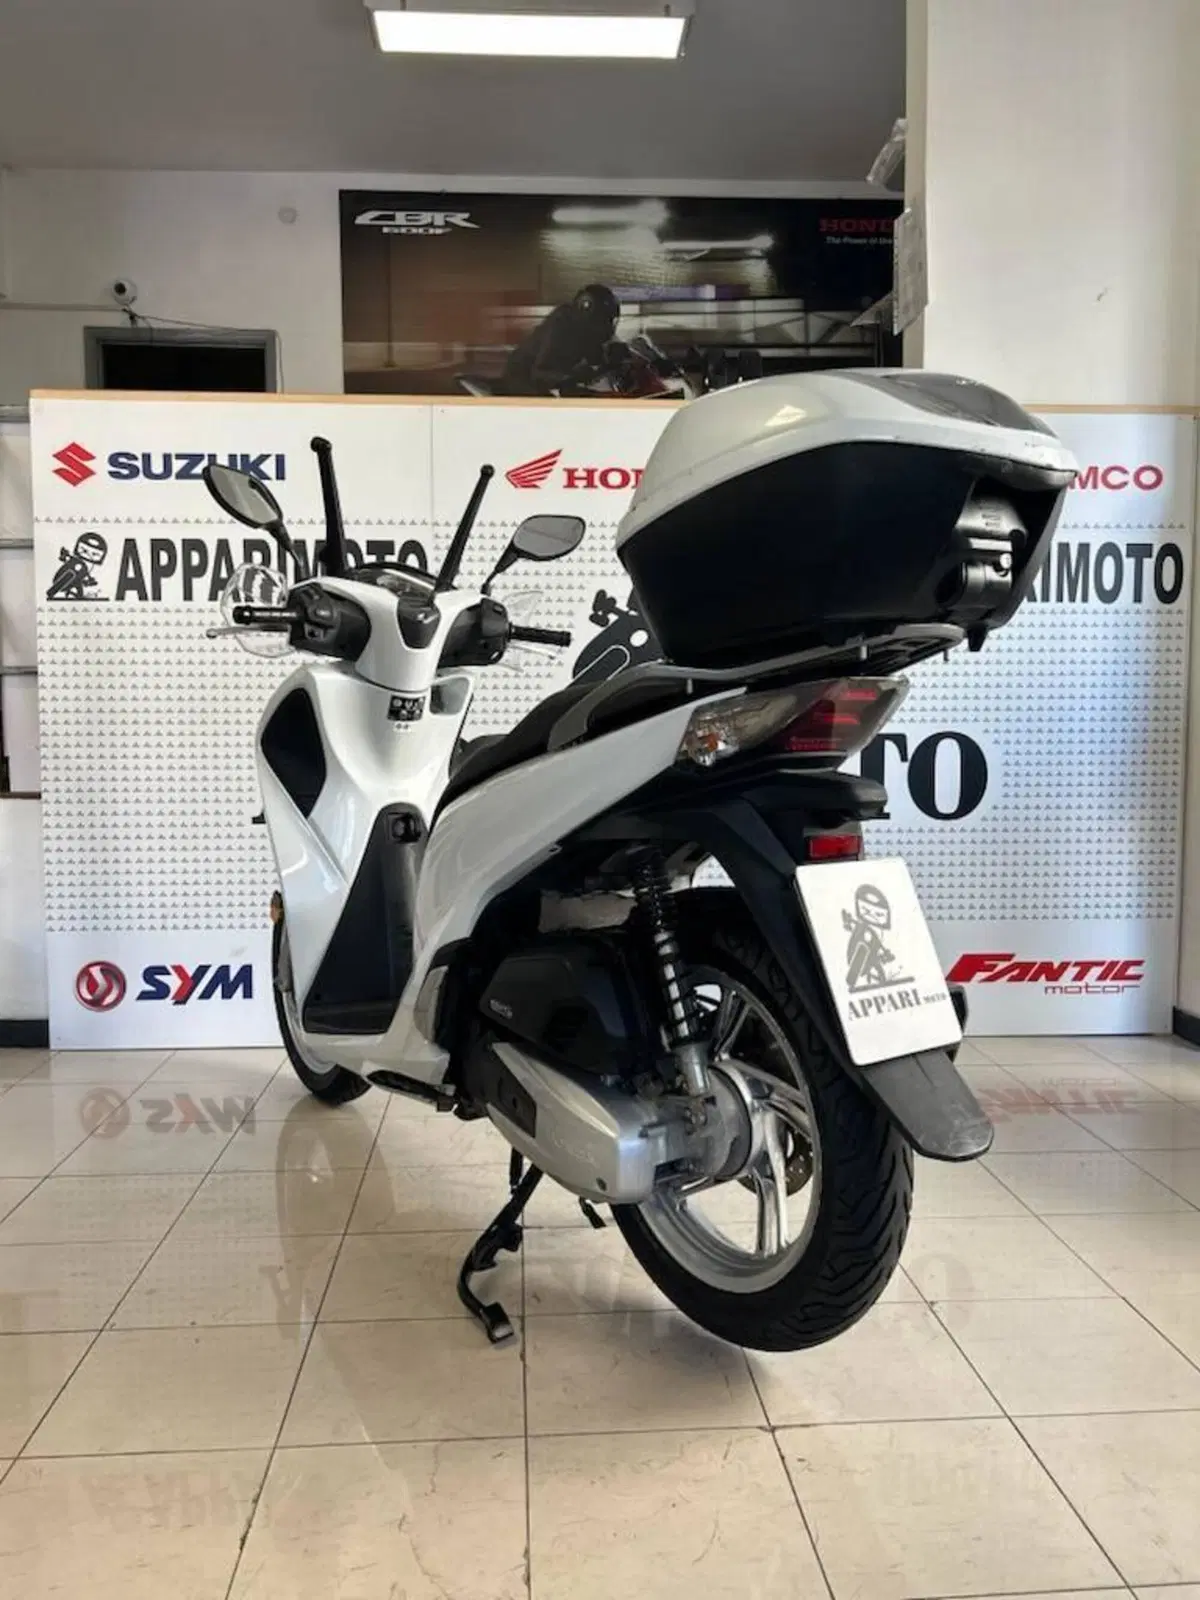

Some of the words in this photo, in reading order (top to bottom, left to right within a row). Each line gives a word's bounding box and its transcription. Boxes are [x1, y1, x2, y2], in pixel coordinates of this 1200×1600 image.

[354, 210, 480, 228] CBR
[819, 217, 894, 233] HOND
[1025, 541, 1184, 605] IMOTO
[136, 964, 253, 1006] SYM
[1044, 982, 1141, 996] motor
[847, 988, 922, 1022] APPARI
